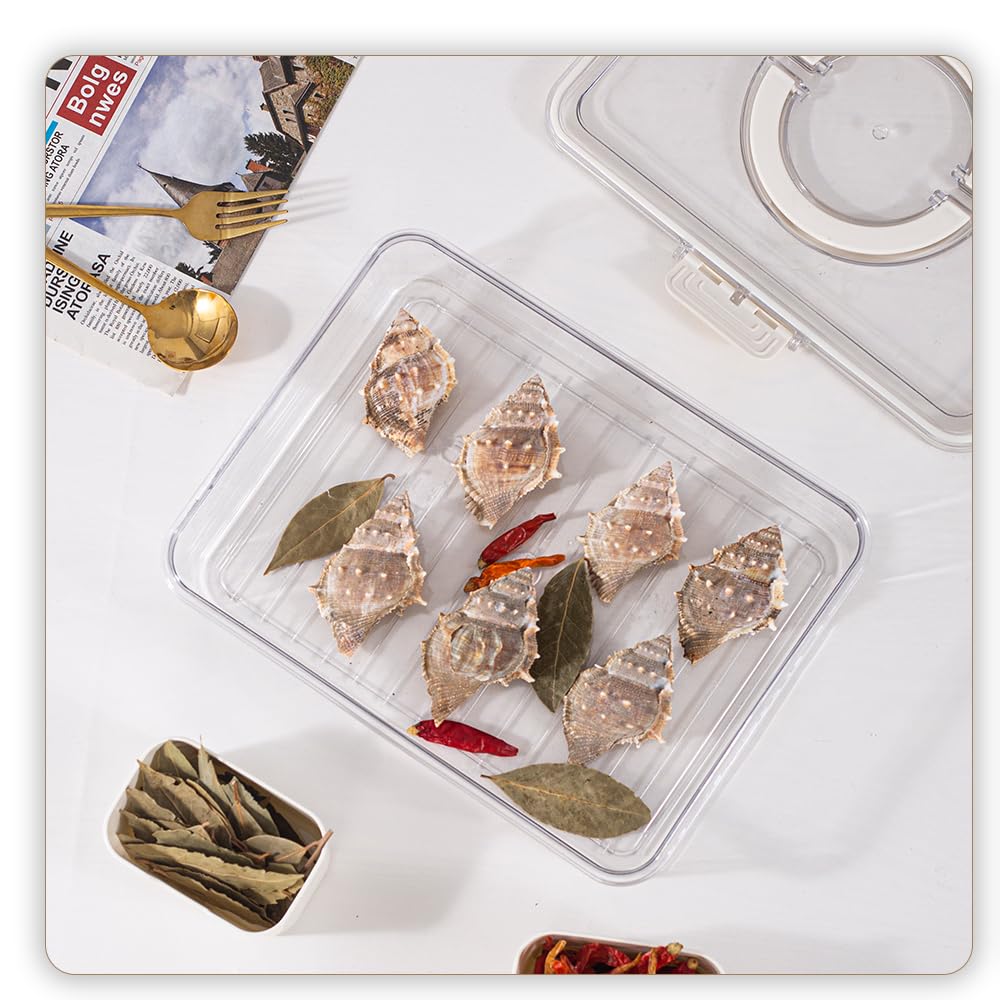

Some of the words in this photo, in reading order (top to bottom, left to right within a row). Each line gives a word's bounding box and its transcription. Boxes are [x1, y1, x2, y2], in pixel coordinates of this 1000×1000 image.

[66, 64, 110, 115] Bolg
[89, 70, 128, 128] nwes
[46, 131, 64, 164] RSTOR
[49, 144, 70, 173] ATORA
[52, 275, 81, 314] ISING
